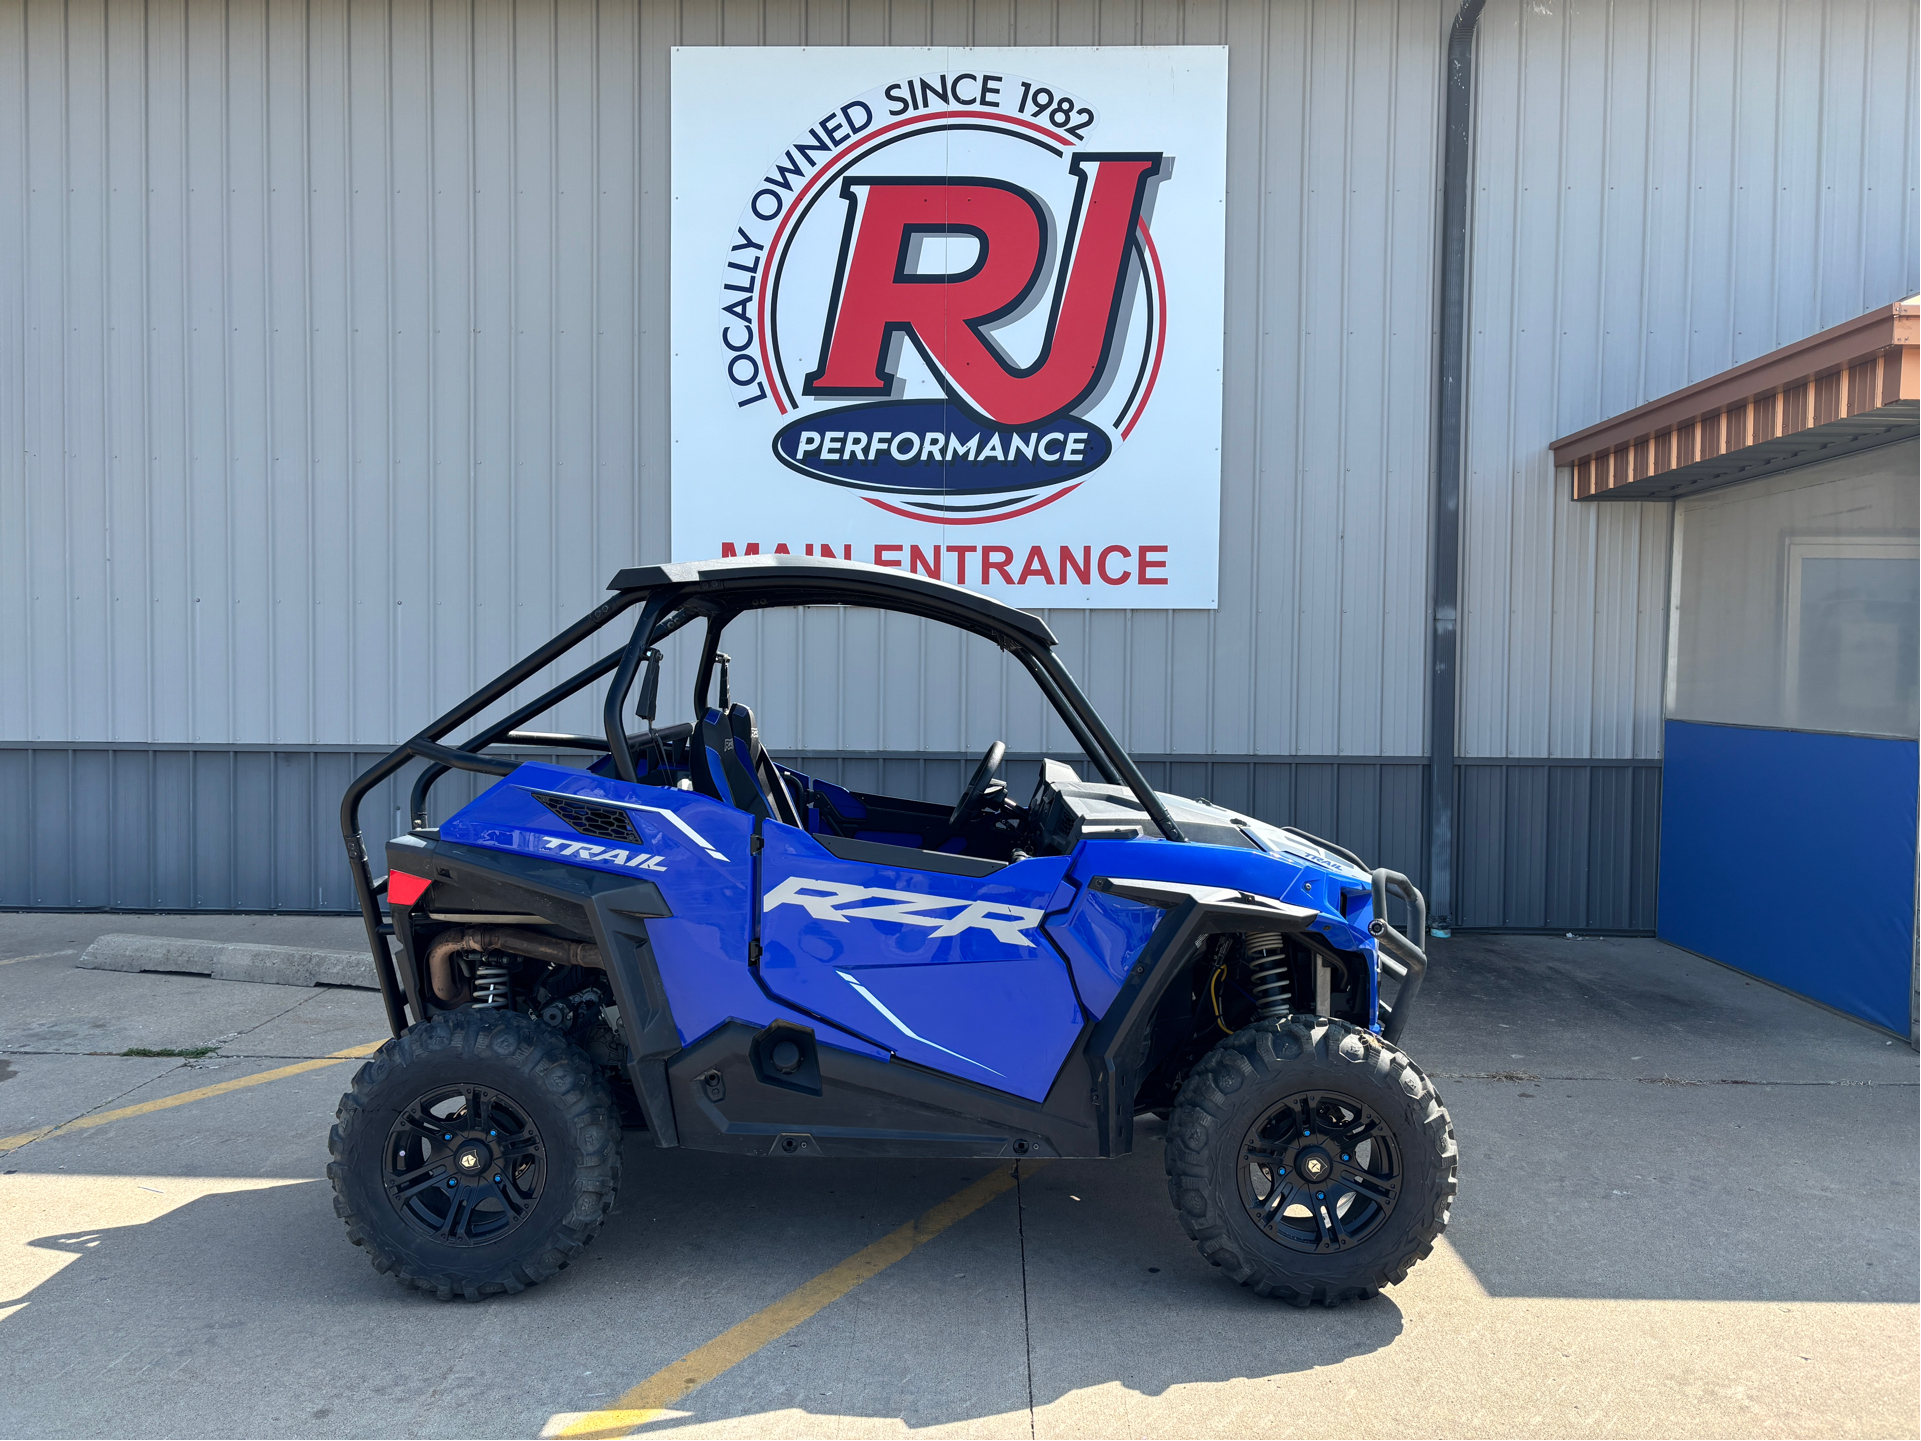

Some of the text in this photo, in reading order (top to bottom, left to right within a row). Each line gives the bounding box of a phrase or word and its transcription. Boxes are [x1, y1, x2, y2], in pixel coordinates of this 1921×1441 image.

[722, 73, 1096, 408] LOCALLY OWNED SINCE 1982
[802, 151, 1164, 432] RJ
[796, 431, 1088, 462] PERFORMANCE
[542, 836, 668, 872] TRAIL
[1304, 851, 1343, 872] TRAIL
[763, 876, 1045, 948] RZR
